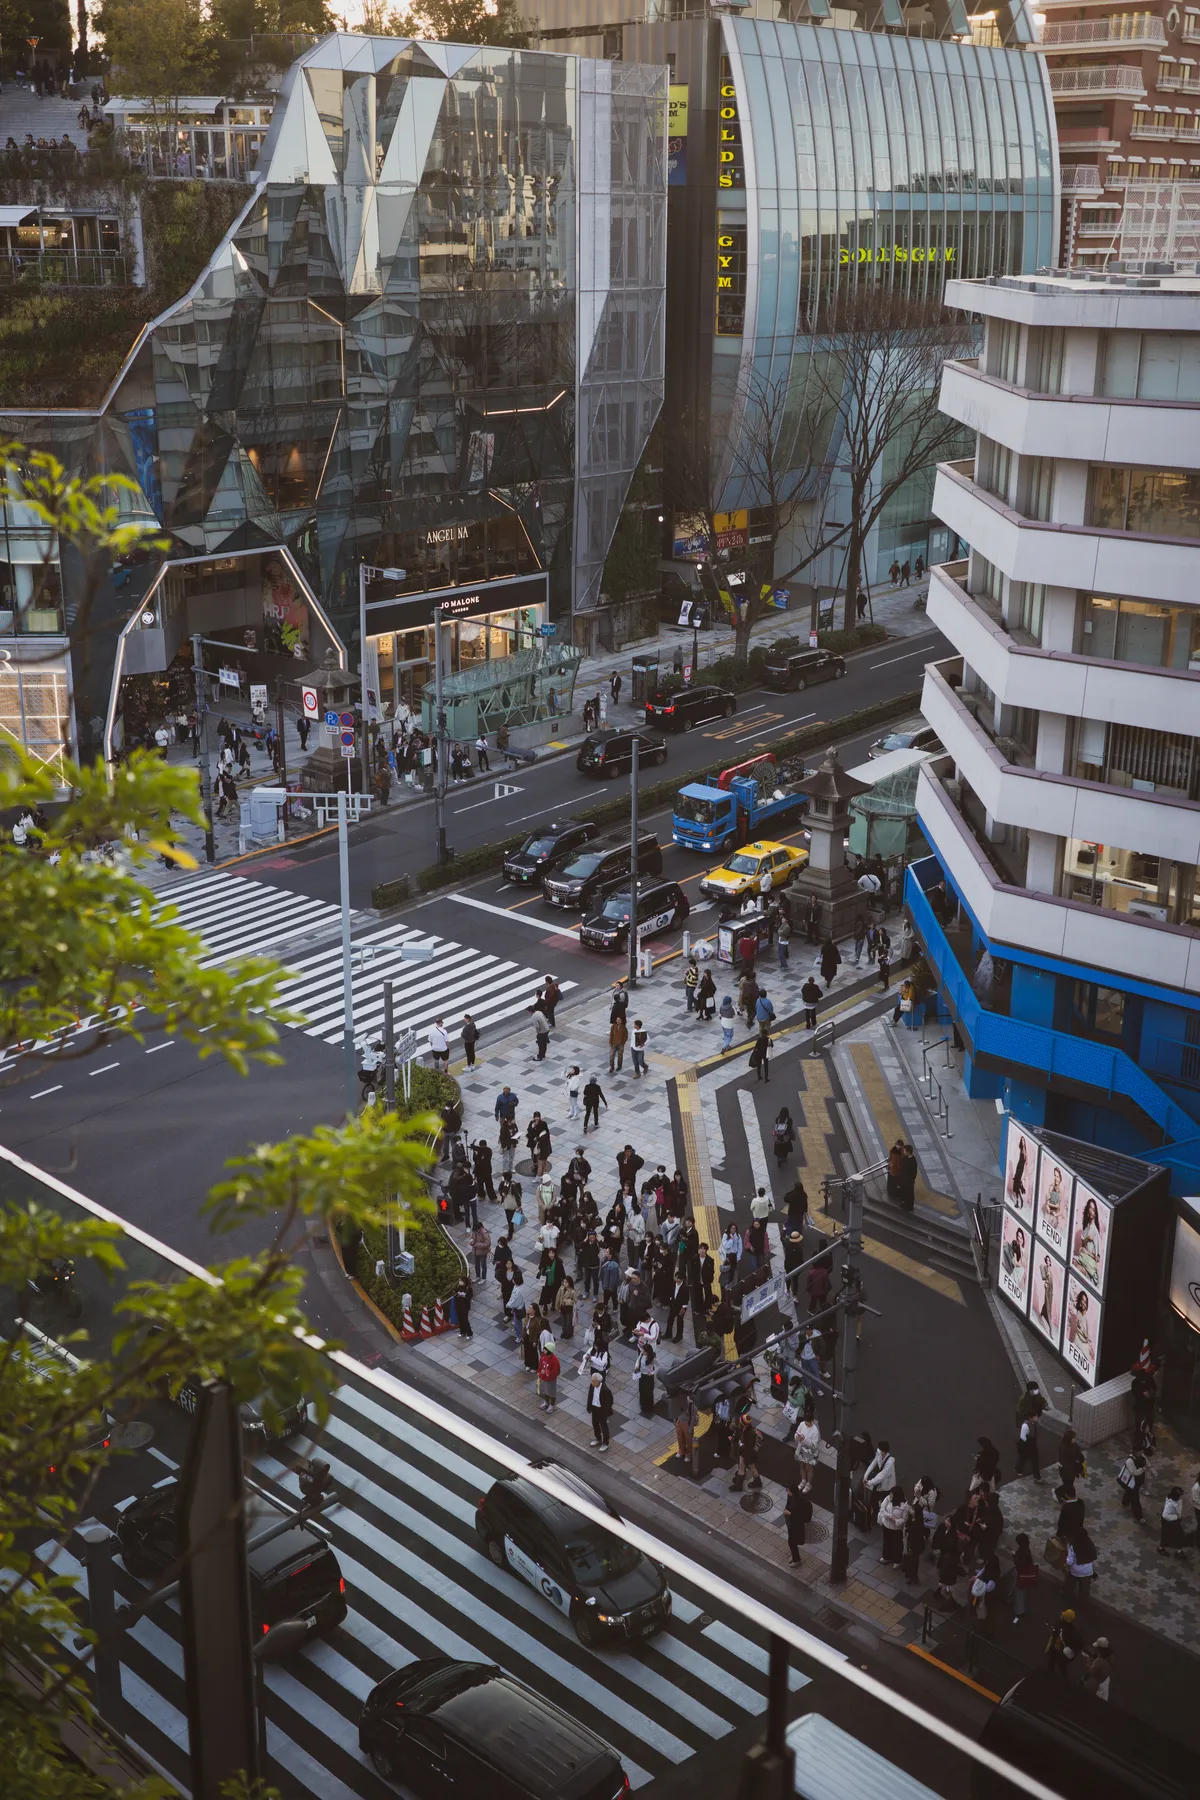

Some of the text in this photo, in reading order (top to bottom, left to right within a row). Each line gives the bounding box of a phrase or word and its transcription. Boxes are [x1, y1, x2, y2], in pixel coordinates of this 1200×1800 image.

[718, 85, 736, 288] GOLD'S GYM
[426, 526, 469, 544] ANGELNA
[440, 596, 480, 610] JO MALONE
[1042, 1219, 1063, 1248] FENDI
[1003, 1274, 1023, 1302] FENDI
[1068, 1343, 1090, 1374] FENDI
